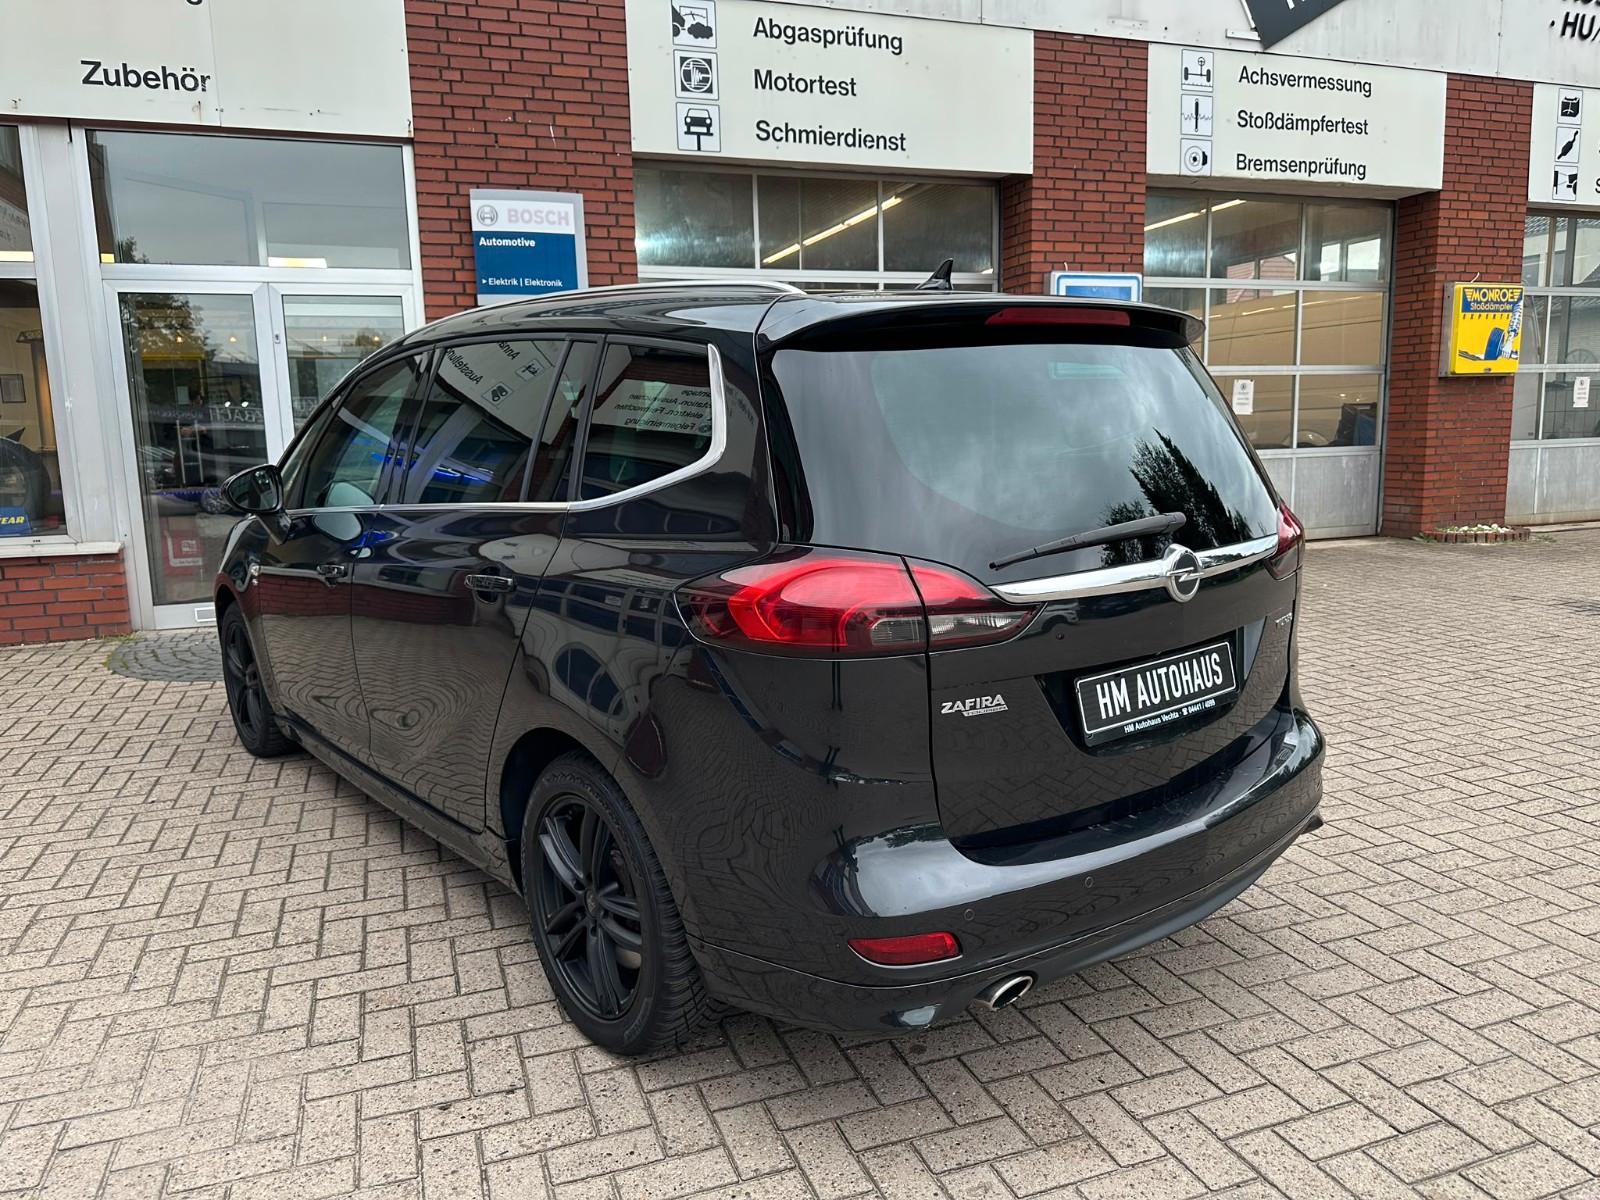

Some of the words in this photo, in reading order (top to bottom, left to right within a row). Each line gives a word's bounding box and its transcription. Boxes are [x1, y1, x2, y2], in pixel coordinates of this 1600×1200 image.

[753, 17, 903, 55] Abgasprüfung
[80, 60, 211, 92] Zubehör
[753, 69, 857, 97] Motortest
[1238, 65, 1373, 98] Achsvermessung
[755, 119, 907, 152] Schmierdienst
[1236, 109, 1369, 136] Stoßdämpfertest
[1235, 153, 1367, 180] Bremsenprüfung
[507, 208, 570, 226] BOSCH
[479, 237, 536, 247] Automotive
[488, 278, 518, 286] Elektrik
[524, 278, 563, 287] Elektronik
[1471, 288, 1514, 302] MONROE
[1096, 677, 1131, 719] HM
[1136, 652, 1223, 709] AUTOHAUS
[941, 694, 1006, 714] ZAFIRA
[1124, 724, 1135, 733] HM
[1135, 718, 1161, 730] Autohaus
[1161, 711, 1180, 722] Vechta
